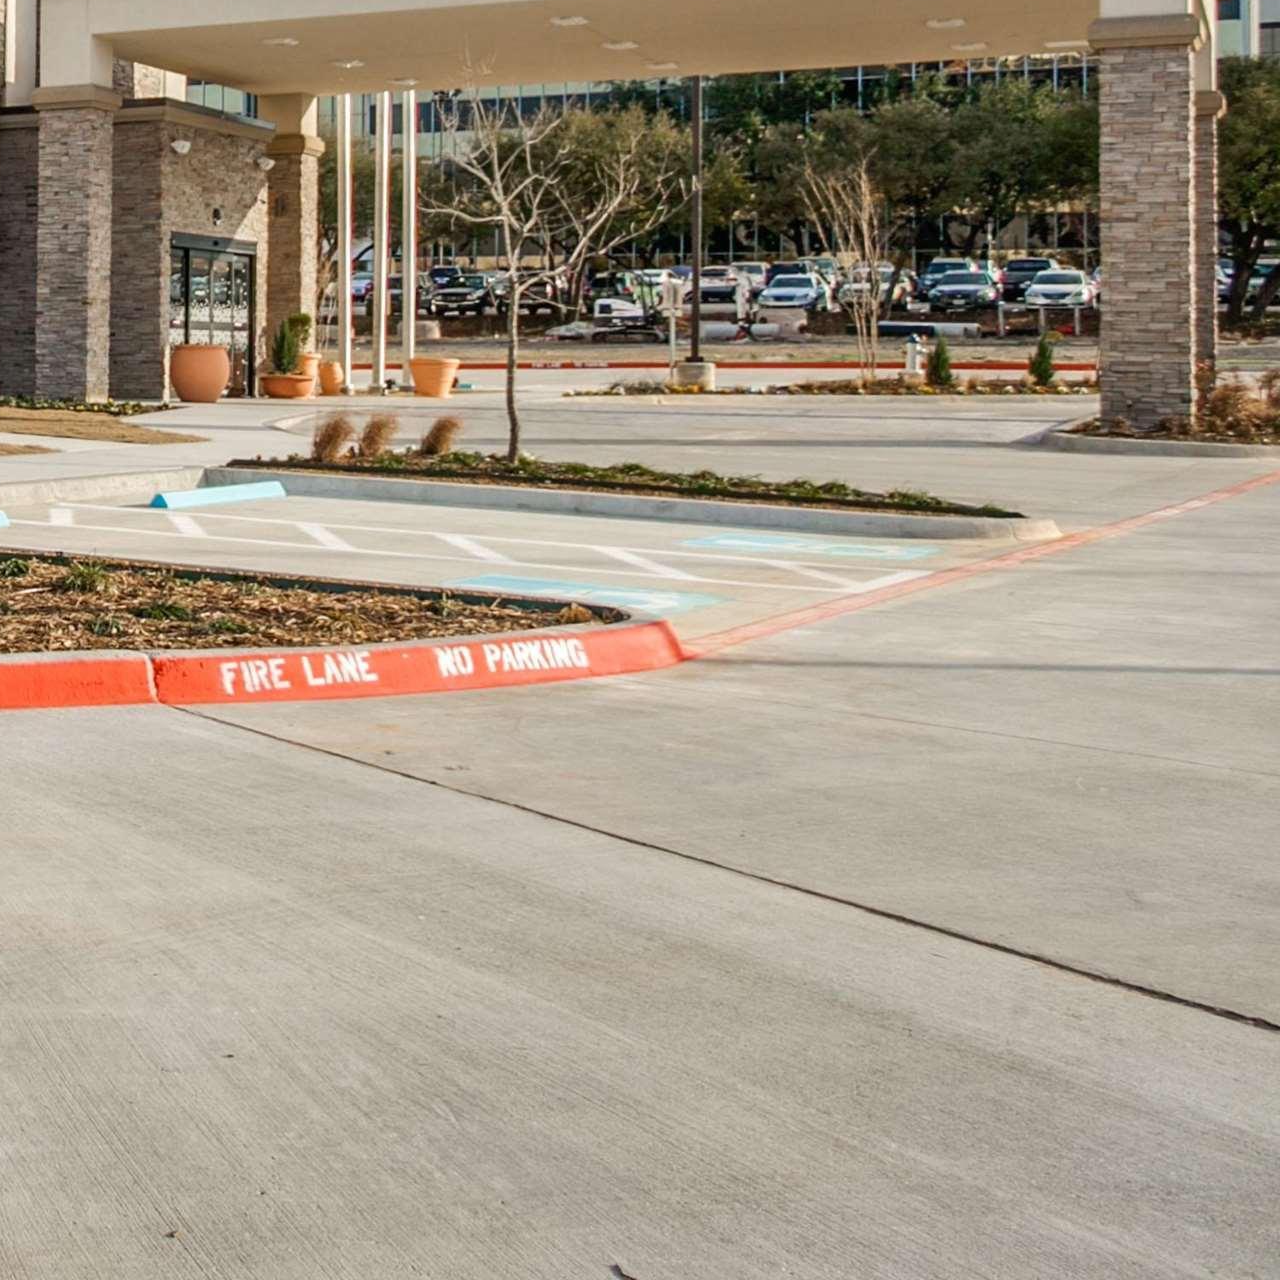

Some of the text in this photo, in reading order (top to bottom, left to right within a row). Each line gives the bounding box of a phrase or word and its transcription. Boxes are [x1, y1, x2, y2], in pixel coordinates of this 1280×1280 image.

[219, 637, 590, 695] FIRE LANE NO PARKING
